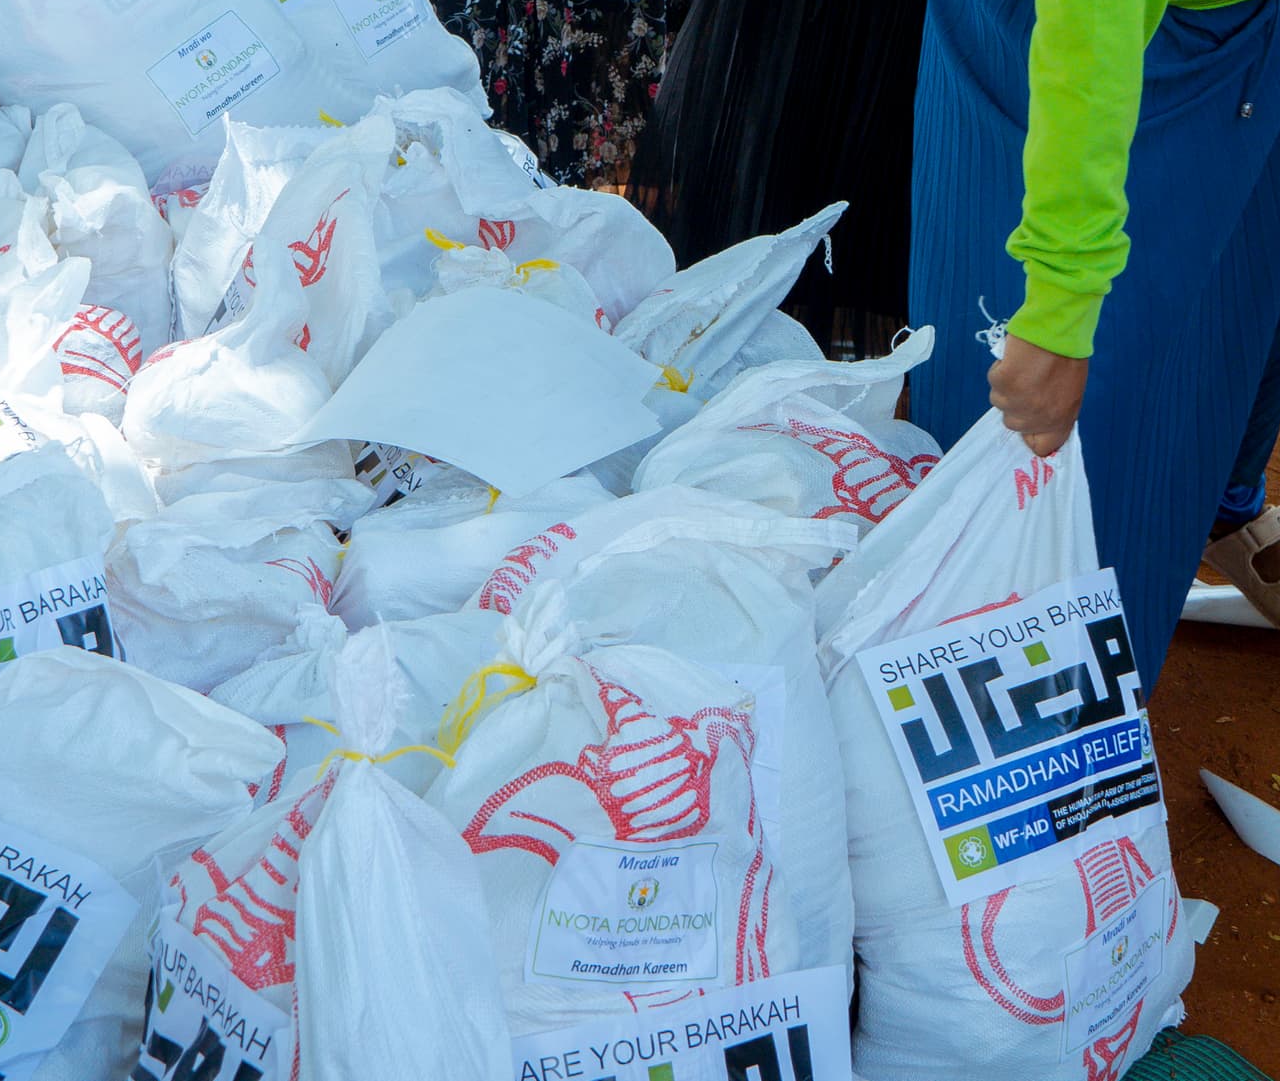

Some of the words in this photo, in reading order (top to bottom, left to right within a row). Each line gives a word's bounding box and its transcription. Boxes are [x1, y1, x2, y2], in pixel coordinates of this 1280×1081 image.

[177, 38, 201, 59] Mradi
[200, 31, 212, 44] wa
[175, 81, 209, 109] NYOTA
[207, 40, 262, 86] FOUNDATION
[206, 90, 242, 119] Ramadhan
[240, 73, 265, 94] Kareem
[879, 640, 968, 685] SHARE
[969, 617, 1046, 654] YOUR
[1046, 588, 1122, 627] BARAK
[937, 749, 1080, 817] RAMADHAN
[1084, 727, 1140, 764] RELIEF
[1052, 807, 1069, 819] THE
[1055, 819, 1066, 830] OF
[994, 818, 1050, 849] WF-AID
[618, 854, 660, 871] Mradi
[661, 856, 680, 867] wa
[547, 909, 611, 934] NYOTA
[616, 911, 713, 934] FOUNDATION
[1101, 917, 1125, 946] Mradi
[570, 960, 640, 976] Ramadhan
[643, 961, 688, 974] Kareem
[1071, 982, 1108, 1017] NYOTA
[1107, 928, 1161, 990] FOUNDATION
[184, 965, 272, 1060] BARAKAH
[1087, 999, 1126, 1036] Ramadhan
[590, 1029, 678, 1070] YOUR
[685, 996, 801, 1049] BARAKAH
